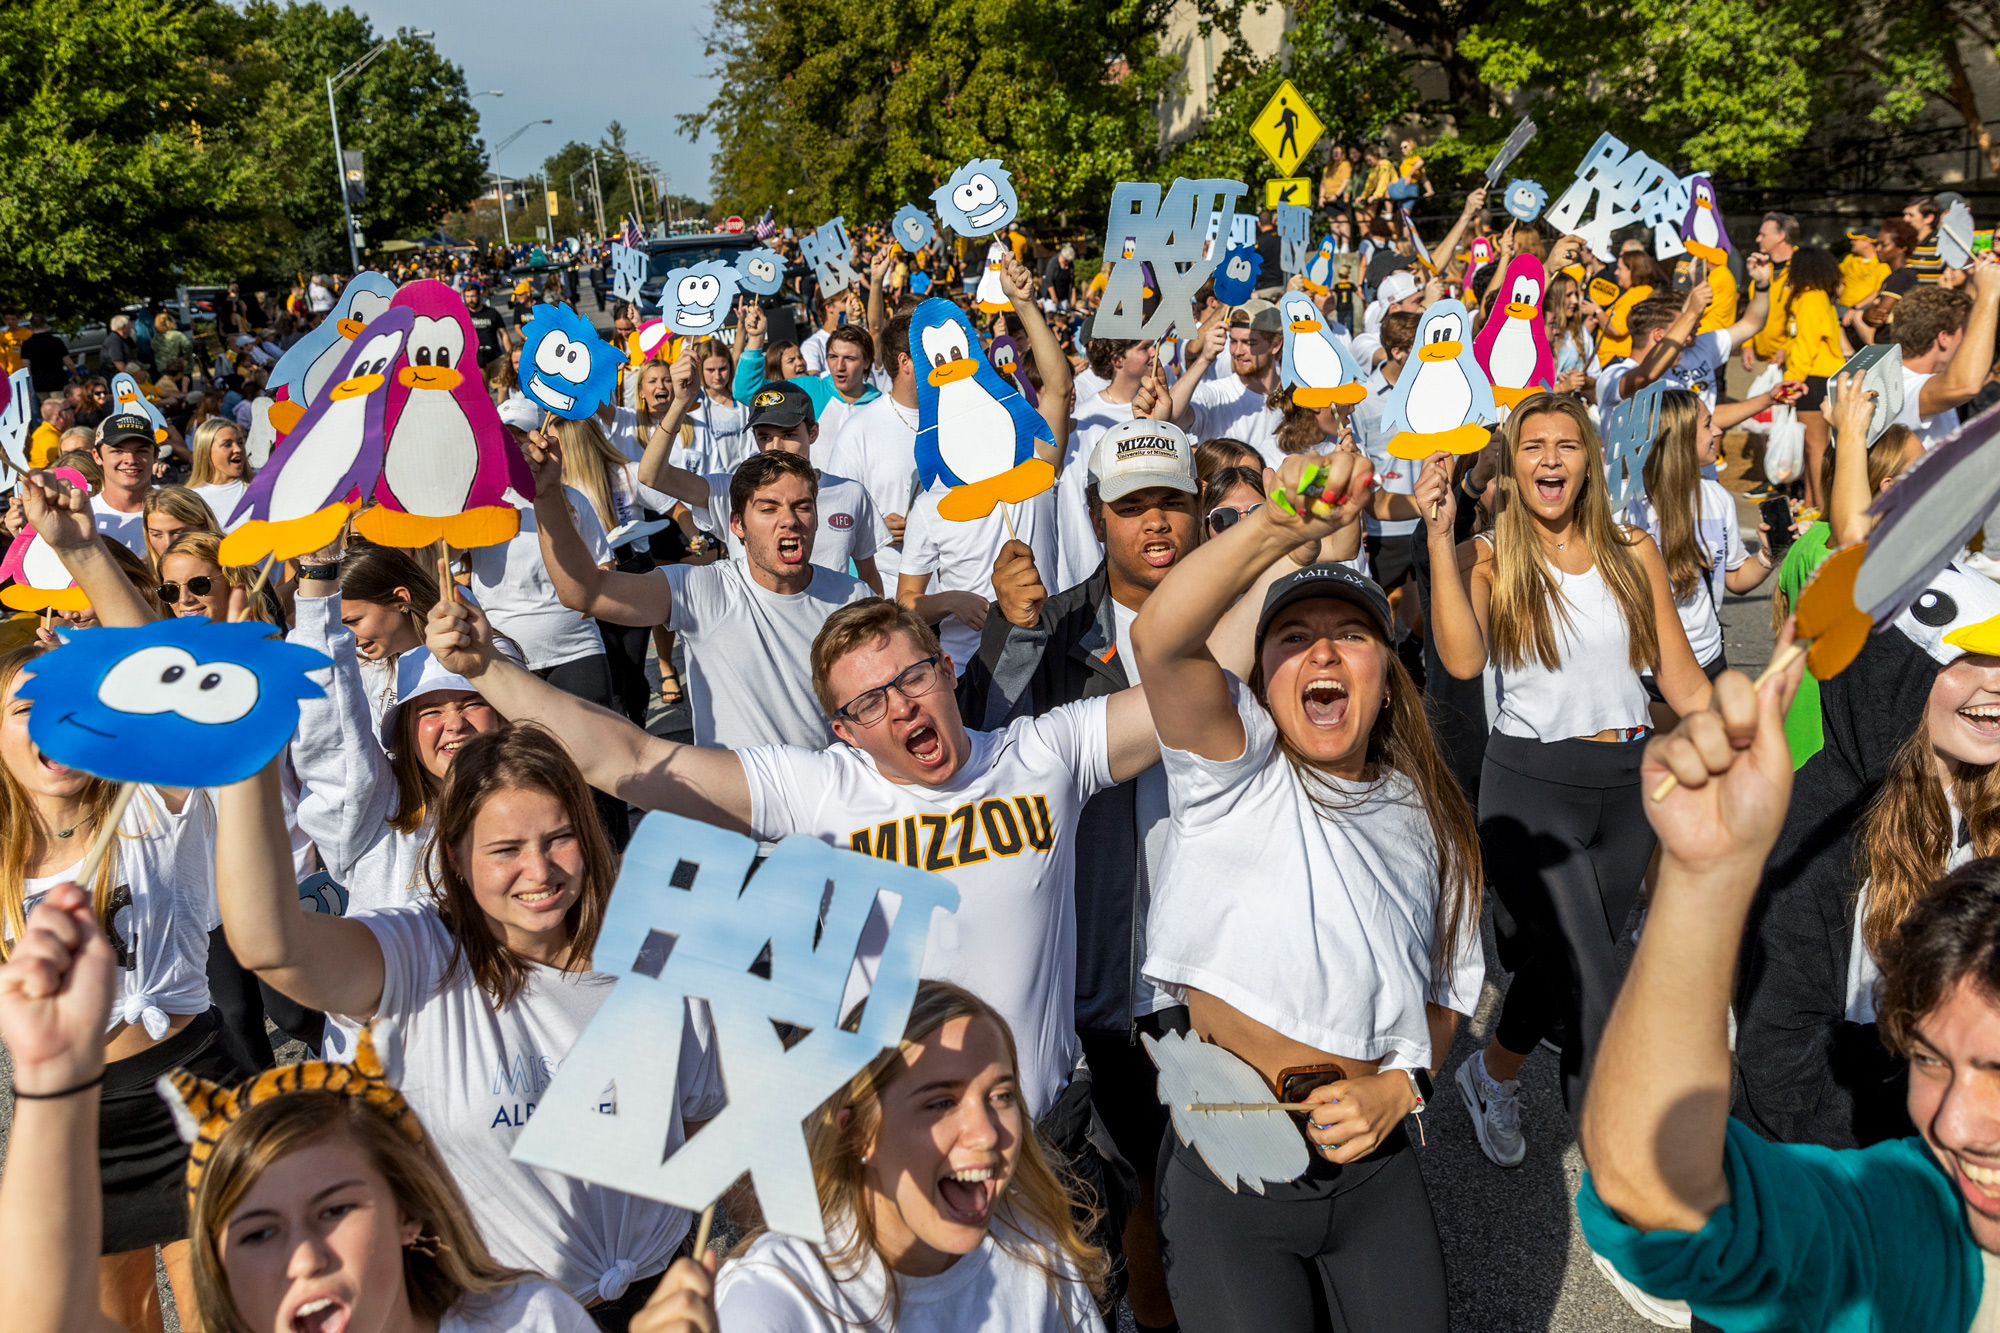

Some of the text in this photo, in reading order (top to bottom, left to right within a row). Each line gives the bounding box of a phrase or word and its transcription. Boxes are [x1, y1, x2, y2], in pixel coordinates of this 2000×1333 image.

[726, 221, 743, 230] STOP
[1117, 437, 1175, 454] MIZZOU
[835, 516, 849, 526] IFC
[850, 795, 1054, 873] MIZZOU
